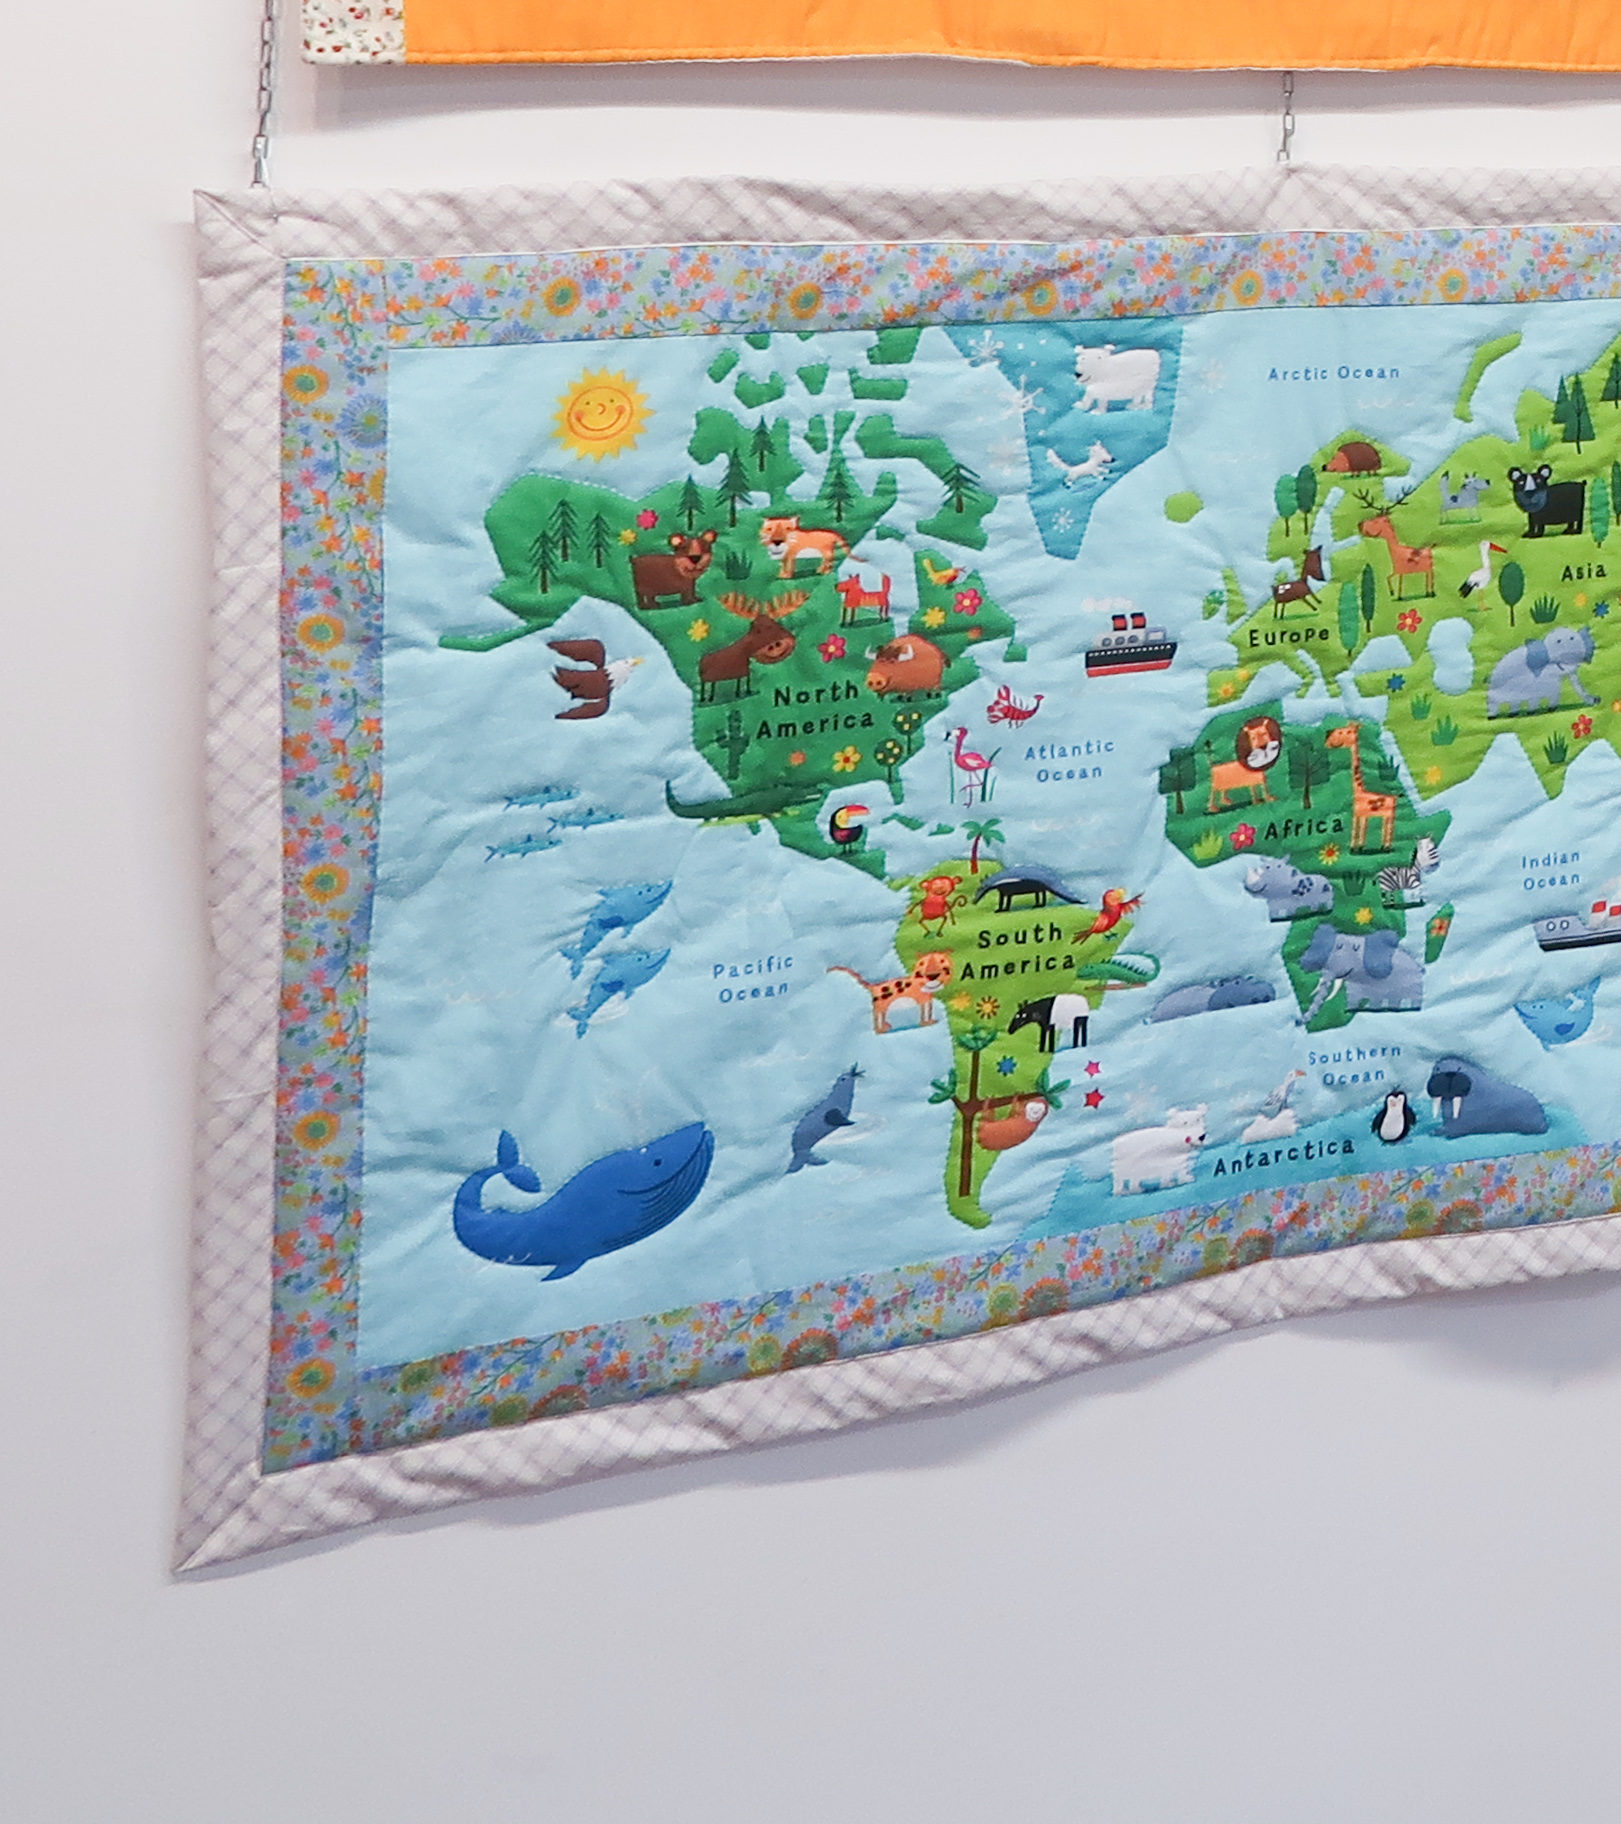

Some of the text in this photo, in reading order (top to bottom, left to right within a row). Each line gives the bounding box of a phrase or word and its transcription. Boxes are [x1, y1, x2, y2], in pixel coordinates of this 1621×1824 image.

[1268, 366, 1400, 381] Arctic Ocean
[1561, 562, 1607, 582] Asia
[1249, 628, 1329, 648] Europe
[774, 679, 858, 707] North
[756, 712, 874, 739] America
[1024, 740, 1115, 761] Atlantic
[1037, 766, 1103, 783] Ocean
[1264, 818, 1344, 841] Africa
[1522, 852, 1580, 869] Indian
[1523, 874, 1580, 891] Ocean
[978, 922, 1062, 949] South
[713, 955, 793, 979] Pacific
[960, 954, 1075, 981] America
[719, 982, 788, 1003] Ocean
[1308, 1046, 1401, 1066] Southern
[1323, 1069, 1385, 1086] Ocean
[1213, 1139, 1355, 1177] Antarctica
